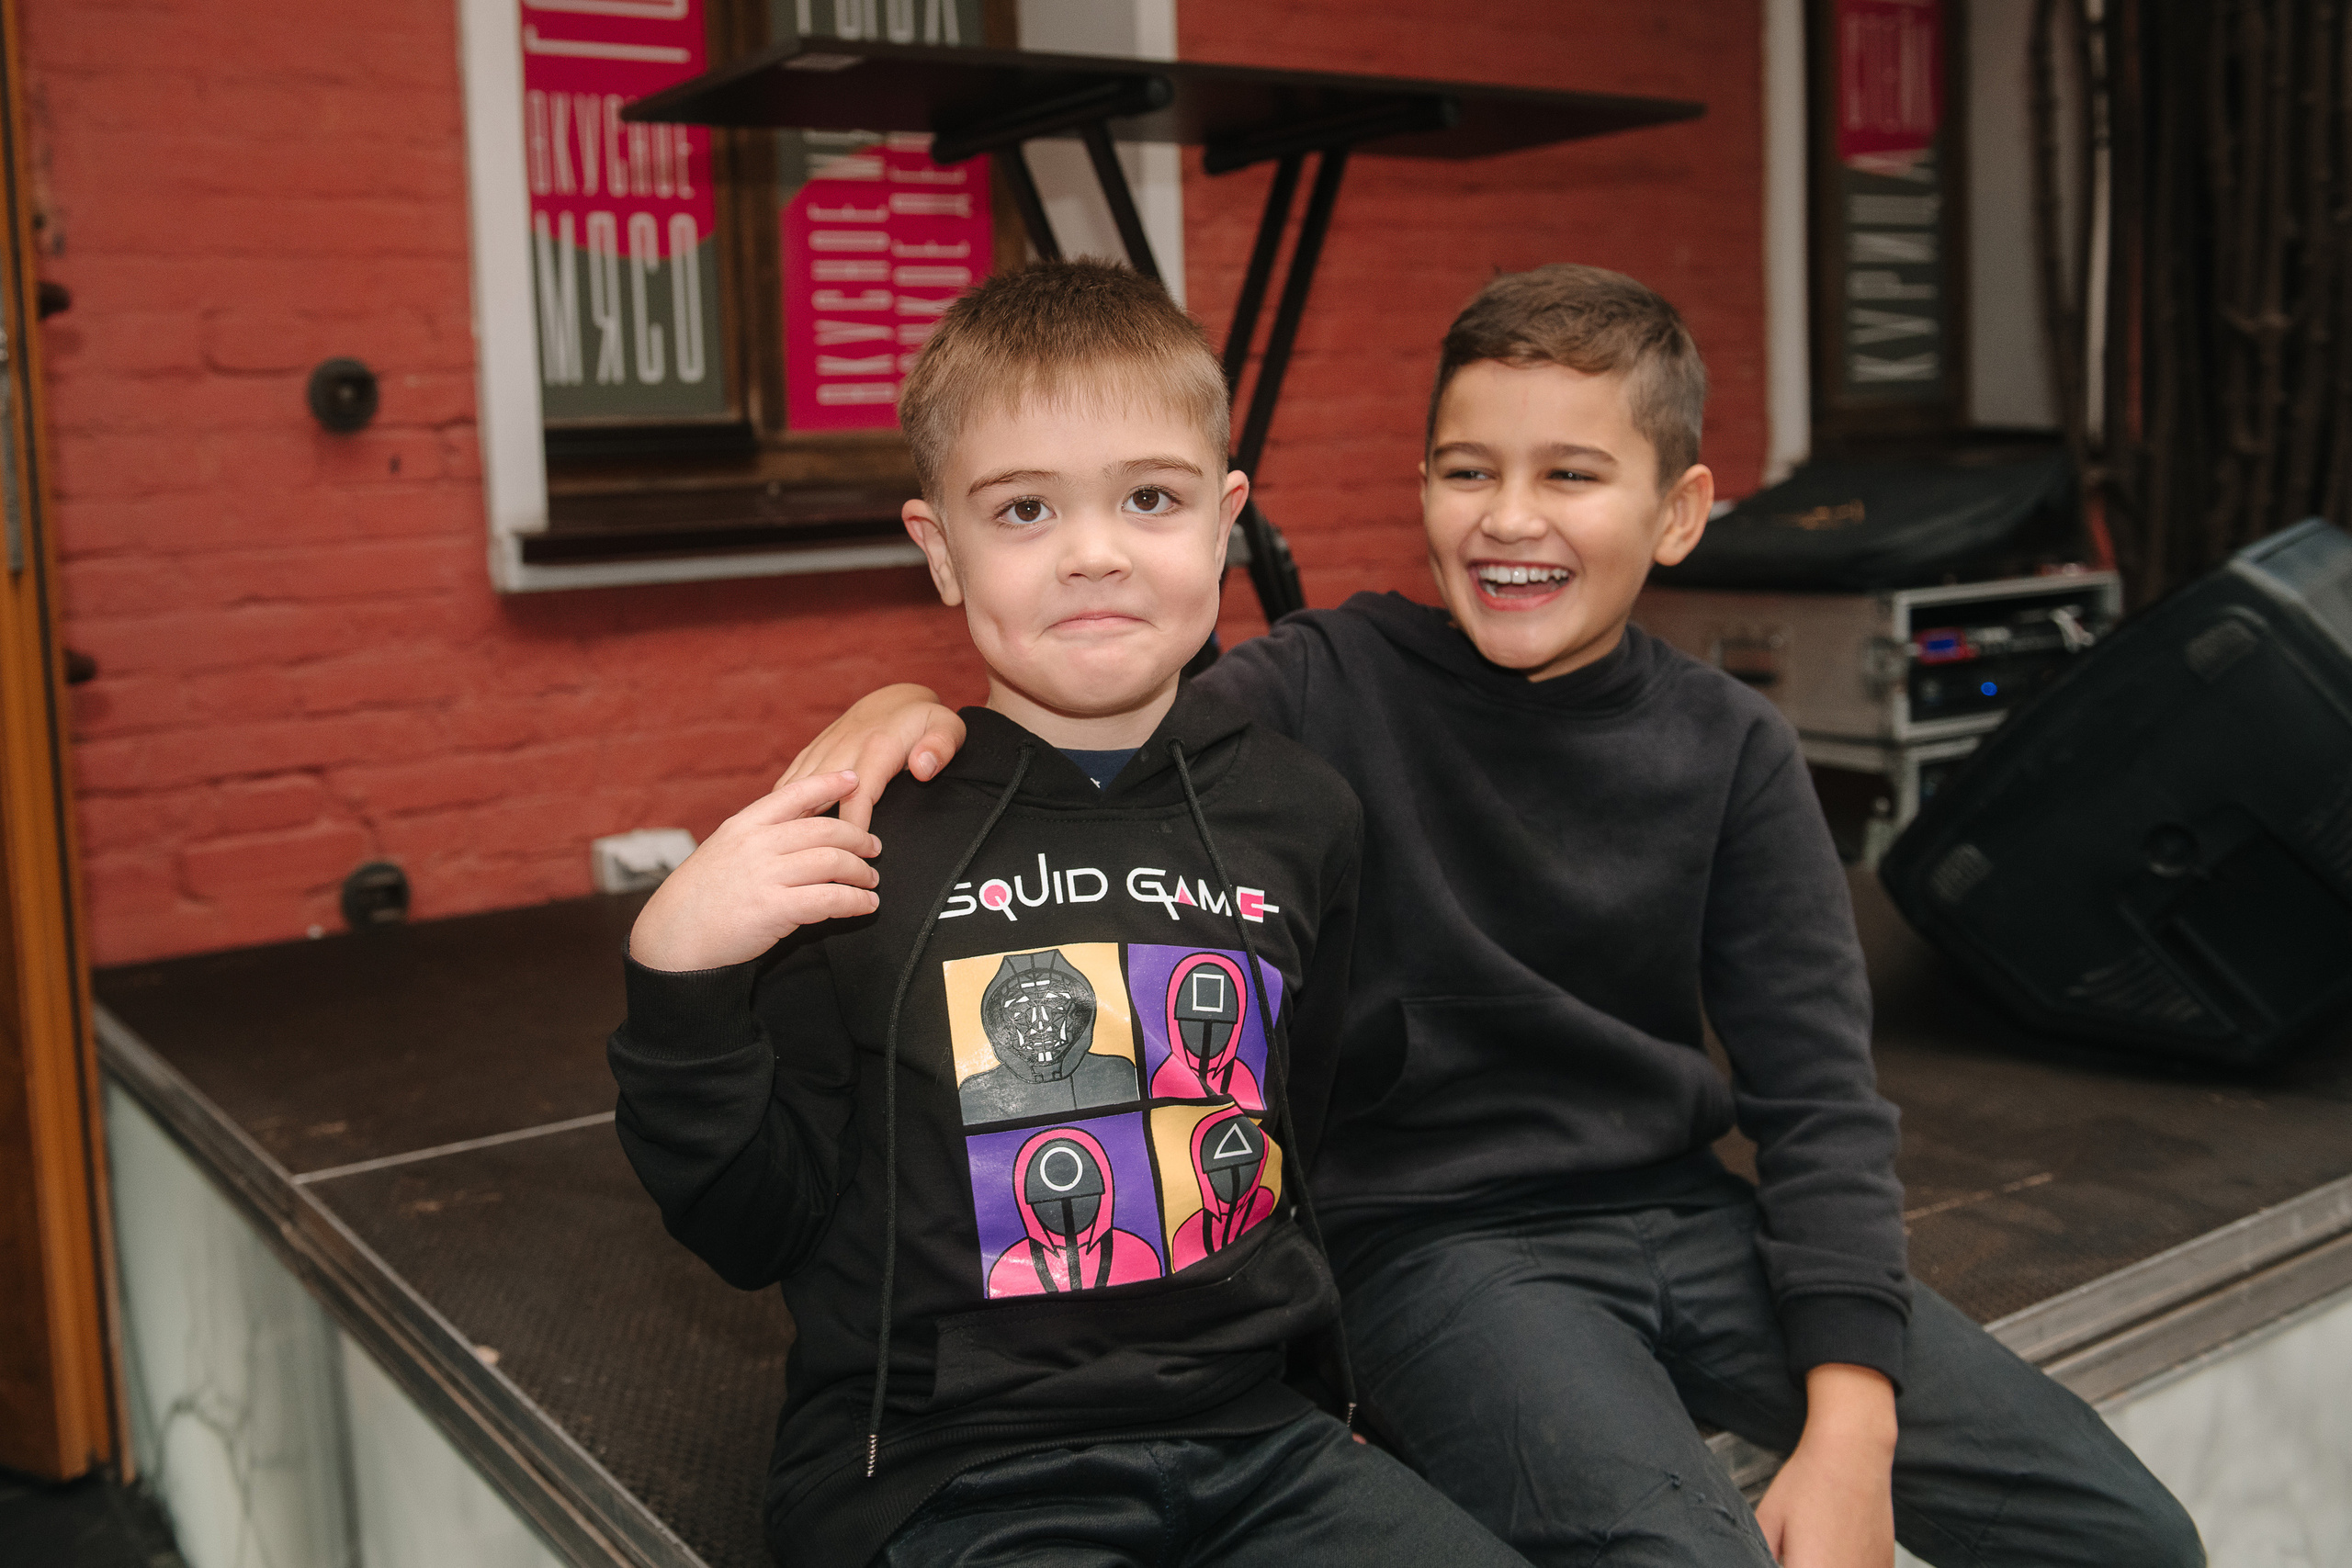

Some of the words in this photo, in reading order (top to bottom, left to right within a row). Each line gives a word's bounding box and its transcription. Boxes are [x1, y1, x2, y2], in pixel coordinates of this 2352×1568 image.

[534, 210, 706, 385] МЯСО
[806, 203, 898, 406] ВКУСНОЕ
[1846, 147, 1940, 382] КУРИЦА
[938, 853, 1108, 921] SQUID
[1126, 867, 1279, 923] GAME
